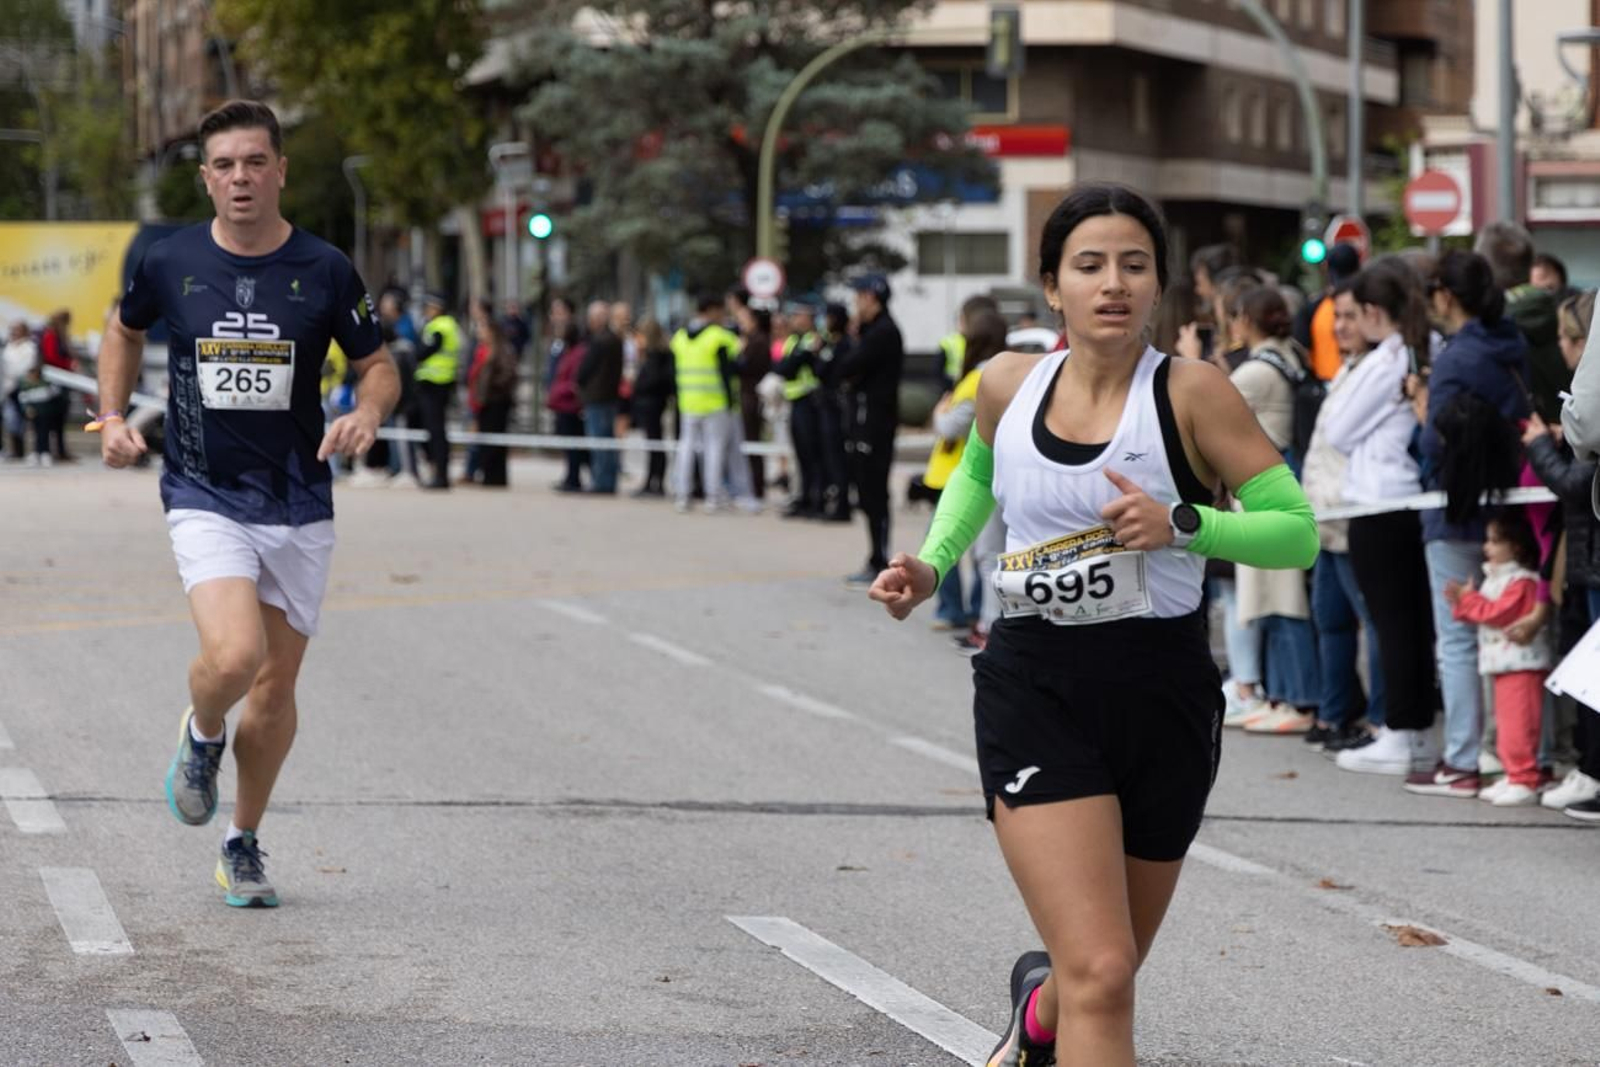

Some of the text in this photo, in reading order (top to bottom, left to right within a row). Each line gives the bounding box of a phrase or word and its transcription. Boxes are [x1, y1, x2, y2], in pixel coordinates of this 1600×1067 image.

[212, 311, 280, 339] 25
[200, 342, 220, 356] XXV
[215, 367, 272, 394] 265
[1004, 551, 1035, 572] XXV
[1035, 537, 1084, 557] CARRERA
[1050, 546, 1079, 562] gran
[1025, 561, 1115, 605] 695
